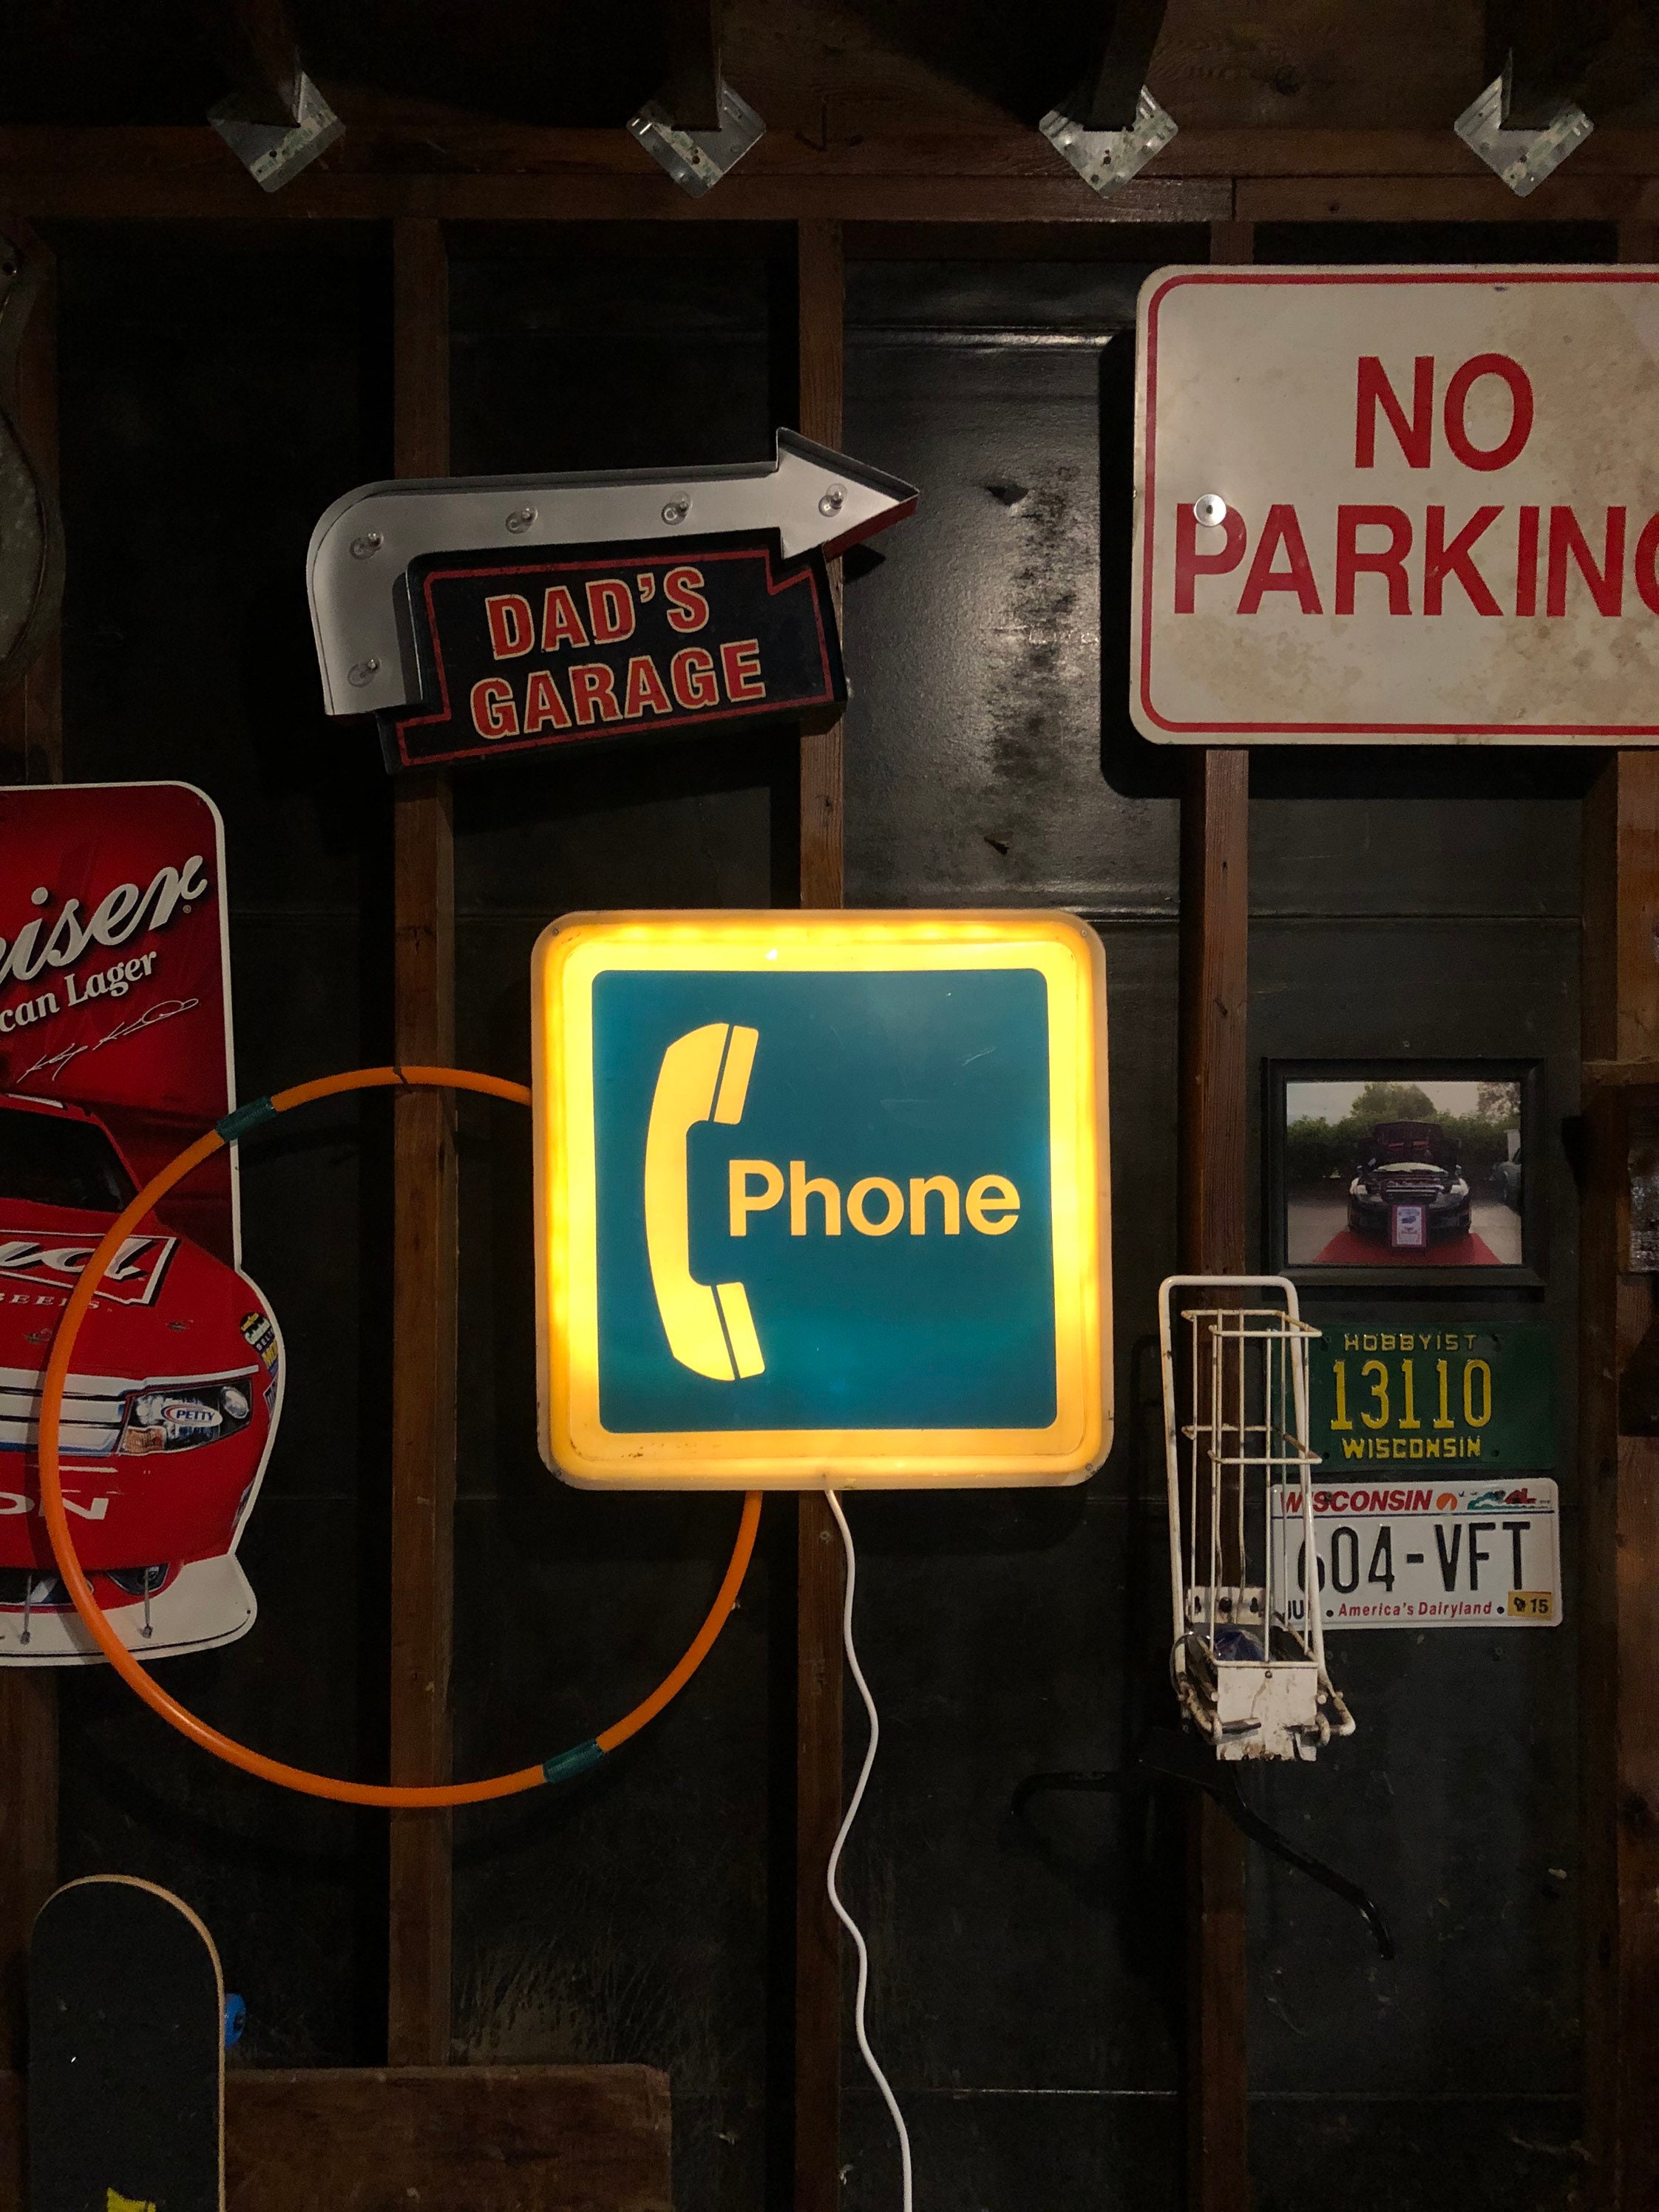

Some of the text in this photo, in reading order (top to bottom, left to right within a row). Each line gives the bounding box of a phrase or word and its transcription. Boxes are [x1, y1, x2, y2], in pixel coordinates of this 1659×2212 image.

[1354, 353, 1535, 472] NO
[486, 566, 710, 660] DAD'S
[469, 639, 767, 740] GARAGE
[0, 855, 208, 983] iser
[64, 951, 157, 1008] Lager
[728, 1159, 1021, 1237] Phone
[0, 1292, 101, 1310] EES
[1344, 1333, 1477, 1352] HOBBYIST
[1331, 1359, 1492, 1431] 13110
[177, 1410, 215, 1421] PETTY
[1342, 1436, 1482, 1460] WISCONSIN
[1280, 1489, 1434, 1513] WSCONSIN
[1338, 1601, 1492, 1618] America's Dairyland
[1530, 1598, 1549, 1614] 15
